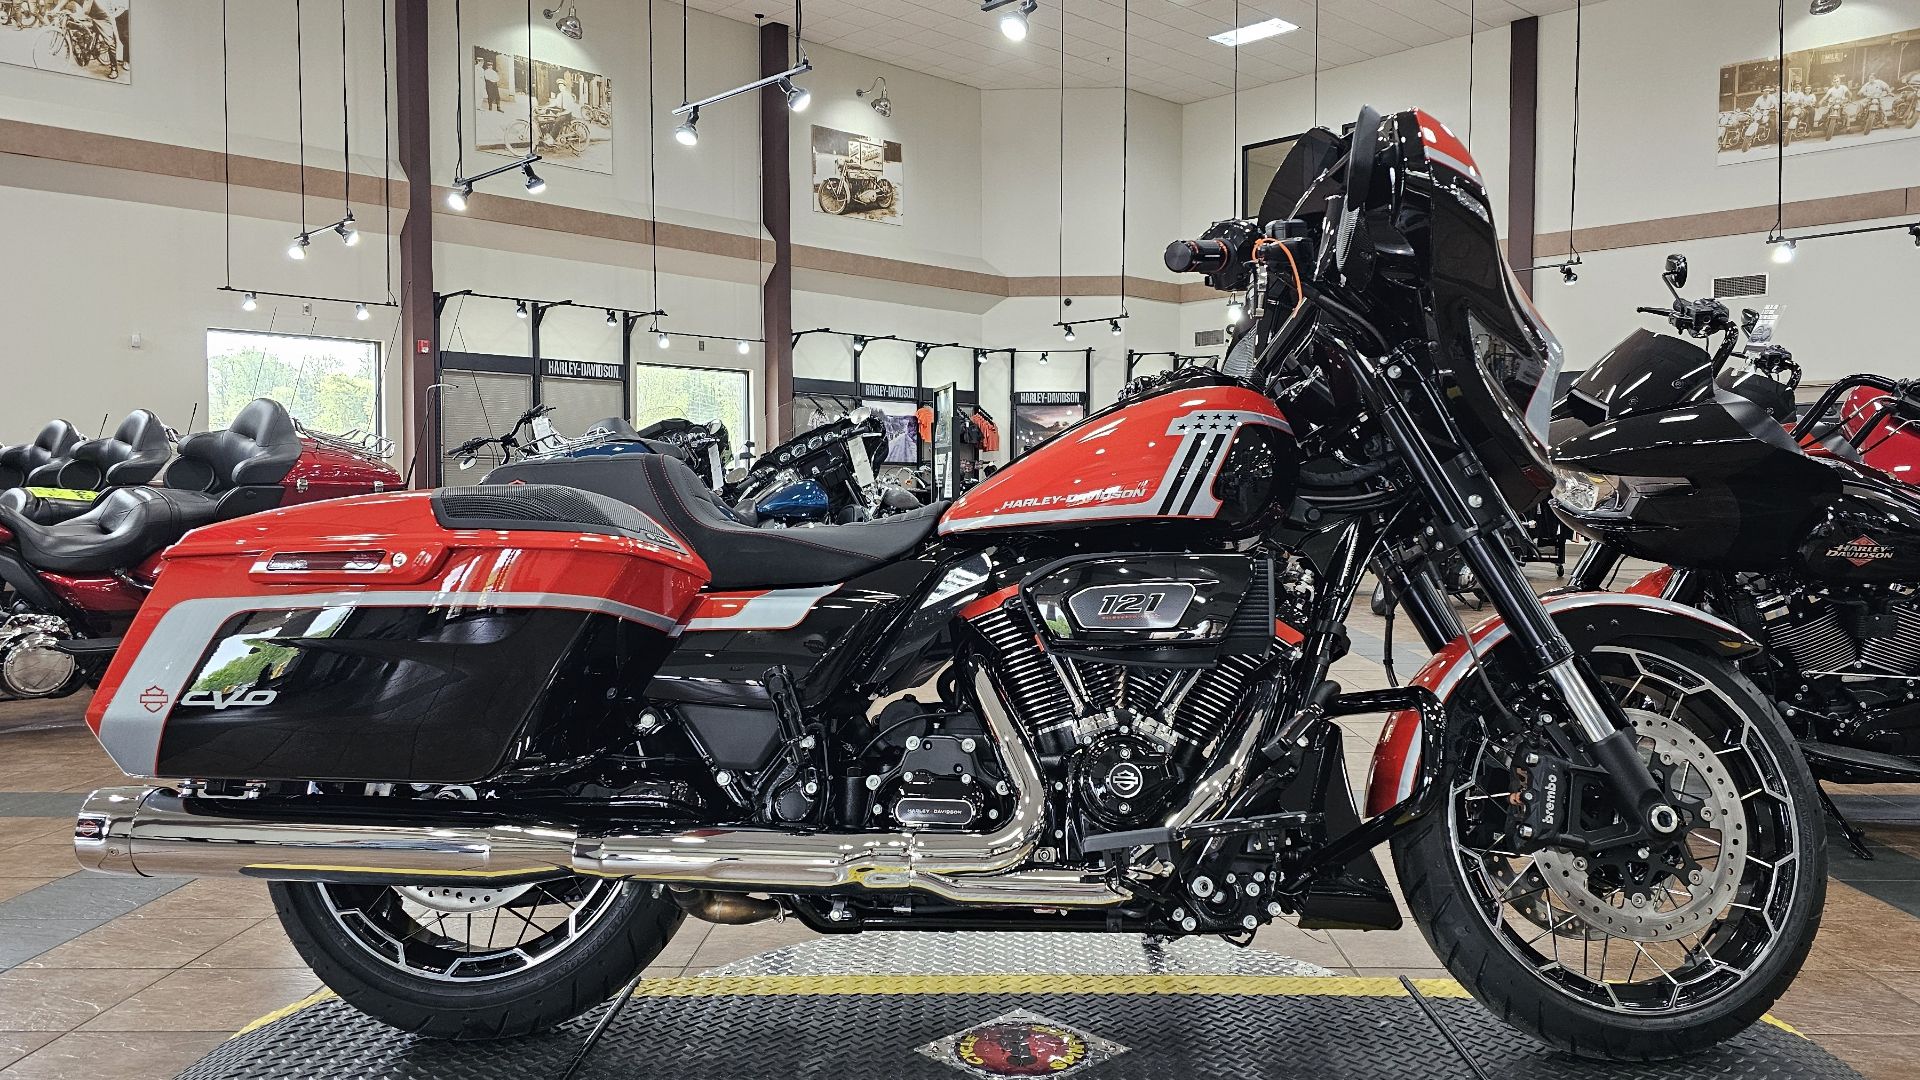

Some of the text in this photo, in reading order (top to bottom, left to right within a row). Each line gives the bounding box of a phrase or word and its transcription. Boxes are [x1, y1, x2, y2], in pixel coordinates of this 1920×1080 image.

[548, 360, 620, 379] HARLEY-DAVIDSON
[865, 384, 915, 399] HARLEY-DAVIDSON
[1020, 392, 1080, 404] HARLEY-DAVIDSON
[1825, 549, 1894, 559] DAVIDSON
[1097, 592, 1166, 616] 121
[180, 689, 278, 710] CVO
[1541, 774, 1558, 825] brembo
